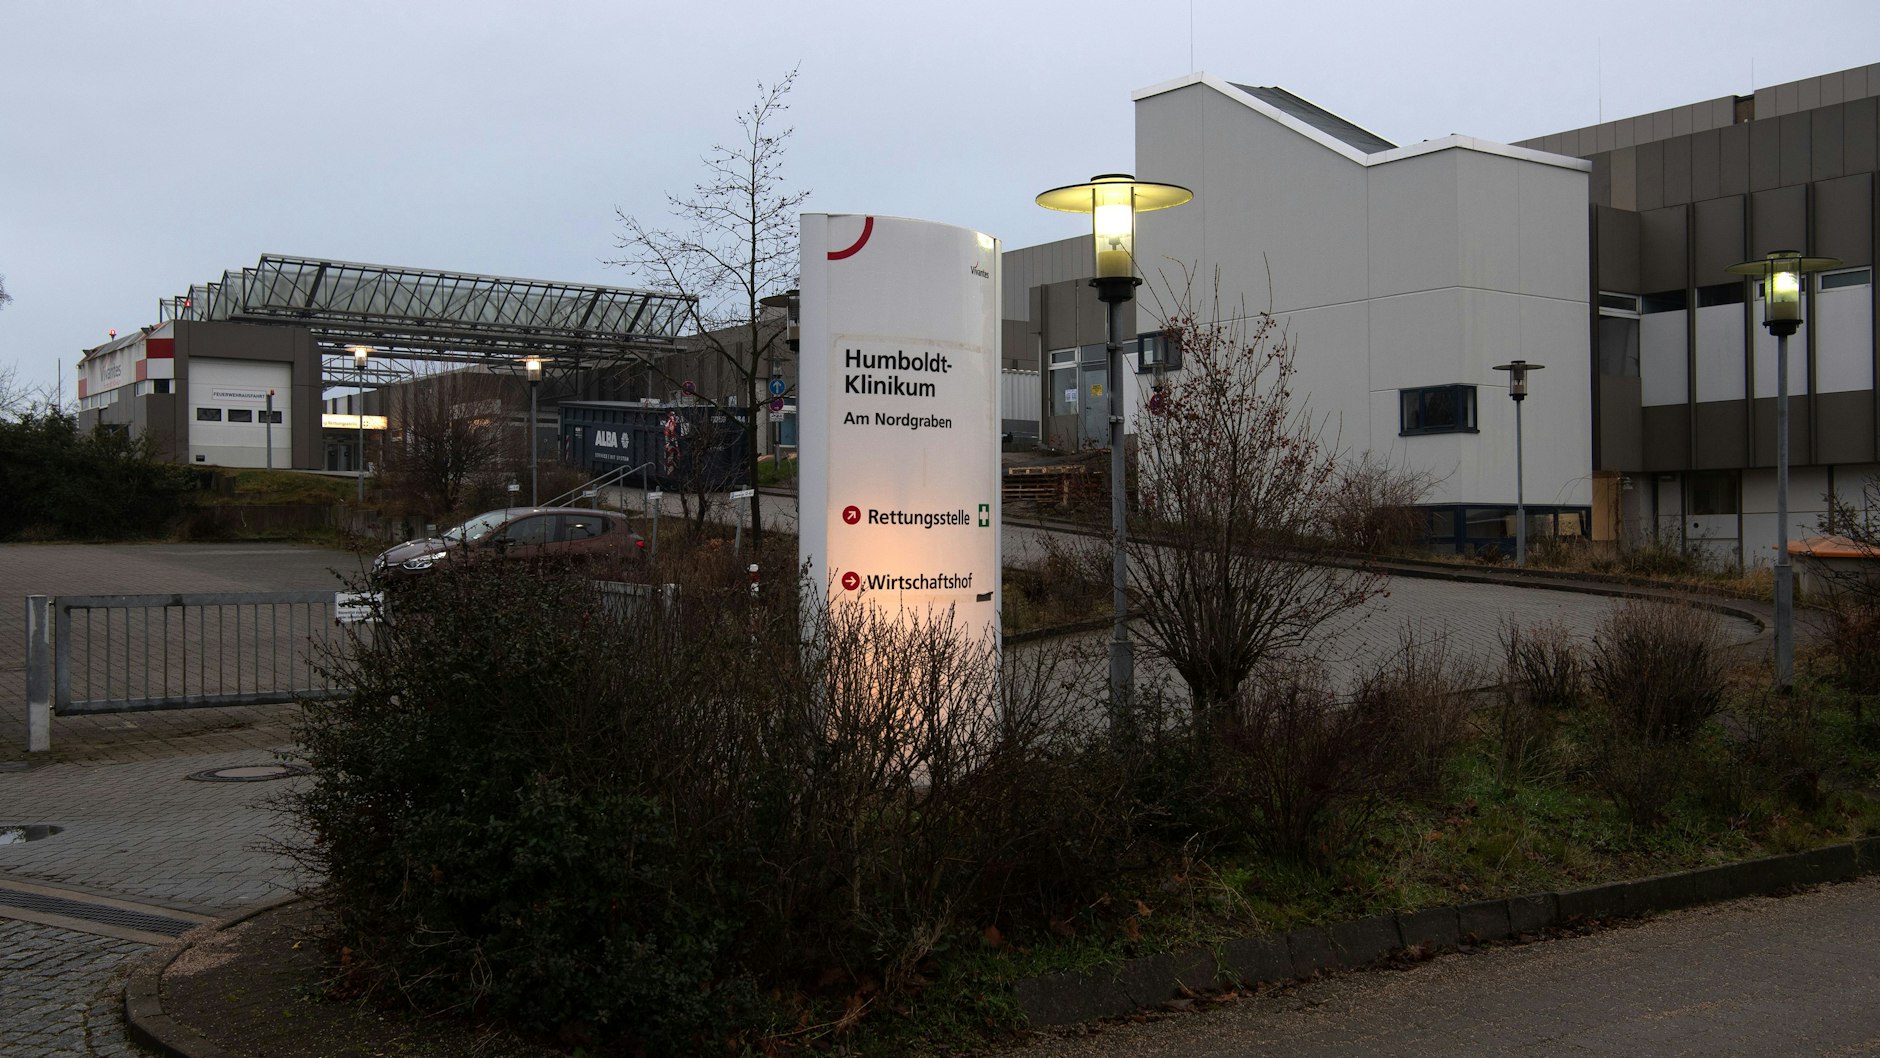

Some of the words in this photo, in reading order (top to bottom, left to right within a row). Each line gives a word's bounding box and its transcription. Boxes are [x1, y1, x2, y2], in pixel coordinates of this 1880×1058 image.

[970, 263, 990, 279] Vivantes
[845, 348, 952, 373] Humboldt-
[845, 373, 936, 397] Klinikum
[213, 391, 265, 399] FEUERWEHRAUSFAHRT
[843, 411, 870, 425] Am
[875, 412, 952, 430] Nordgraben
[594, 430, 618, 449] ALBA
[868, 509, 970, 529] Rettungsstelle
[867, 572, 973, 590] Wirtschaftshof
